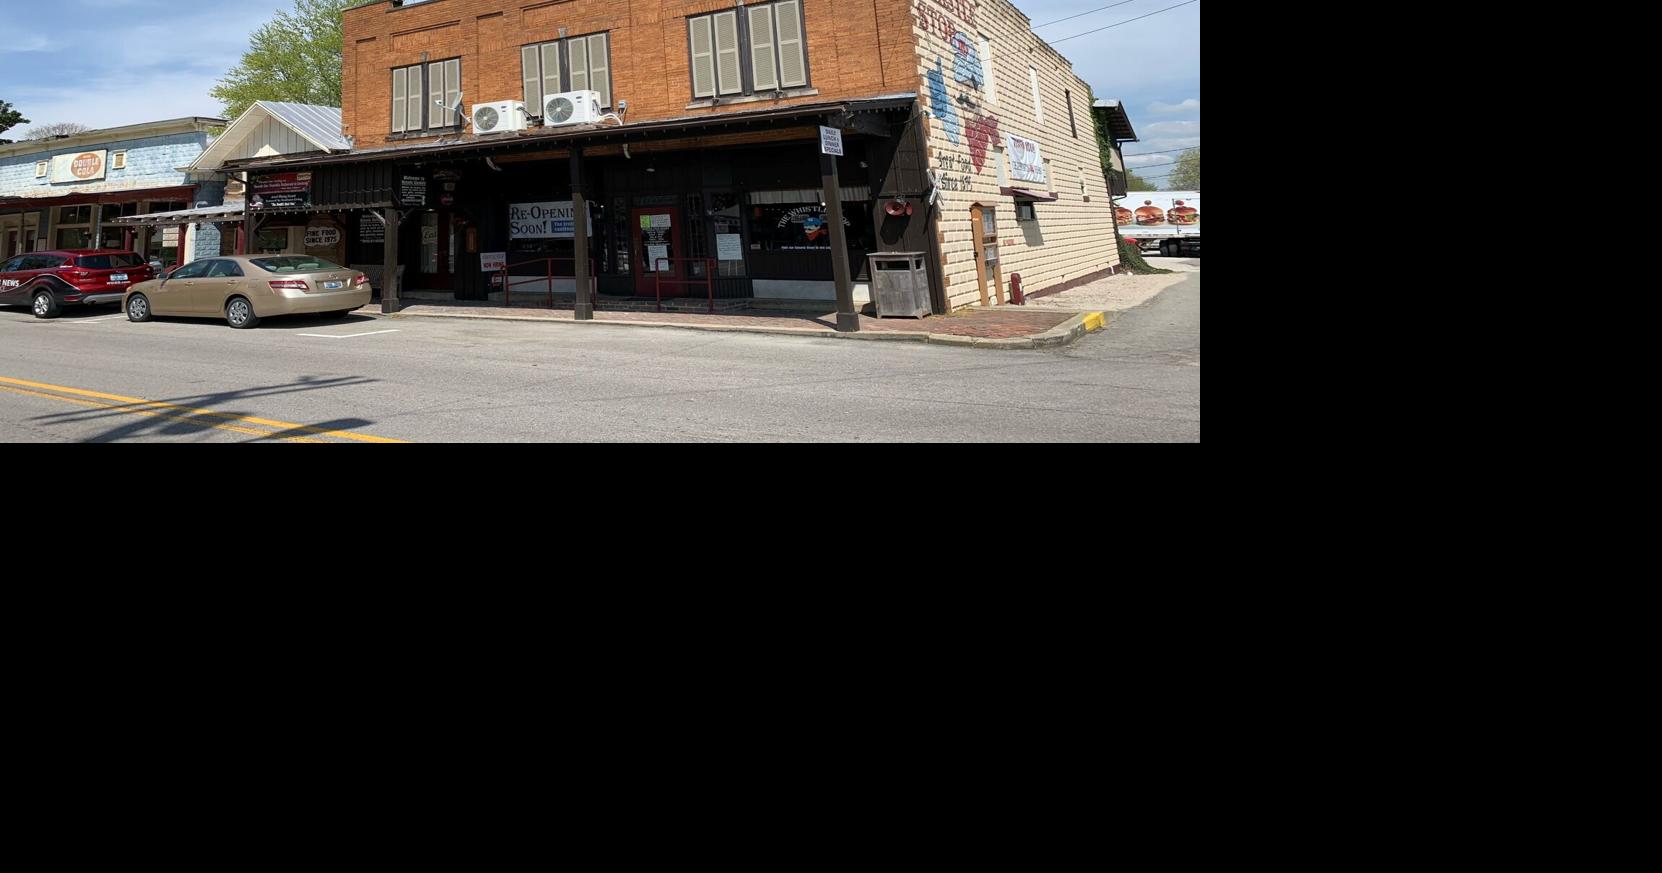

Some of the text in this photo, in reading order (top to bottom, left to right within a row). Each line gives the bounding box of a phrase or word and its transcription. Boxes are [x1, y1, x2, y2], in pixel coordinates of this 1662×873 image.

[917, 3, 956, 45] STOP
[73, 157, 100, 168] DOUBLE
[77, 166, 95, 176] COLA
[777, 214, 791, 229] THE
[2, 279, 20, 287] NEWS
